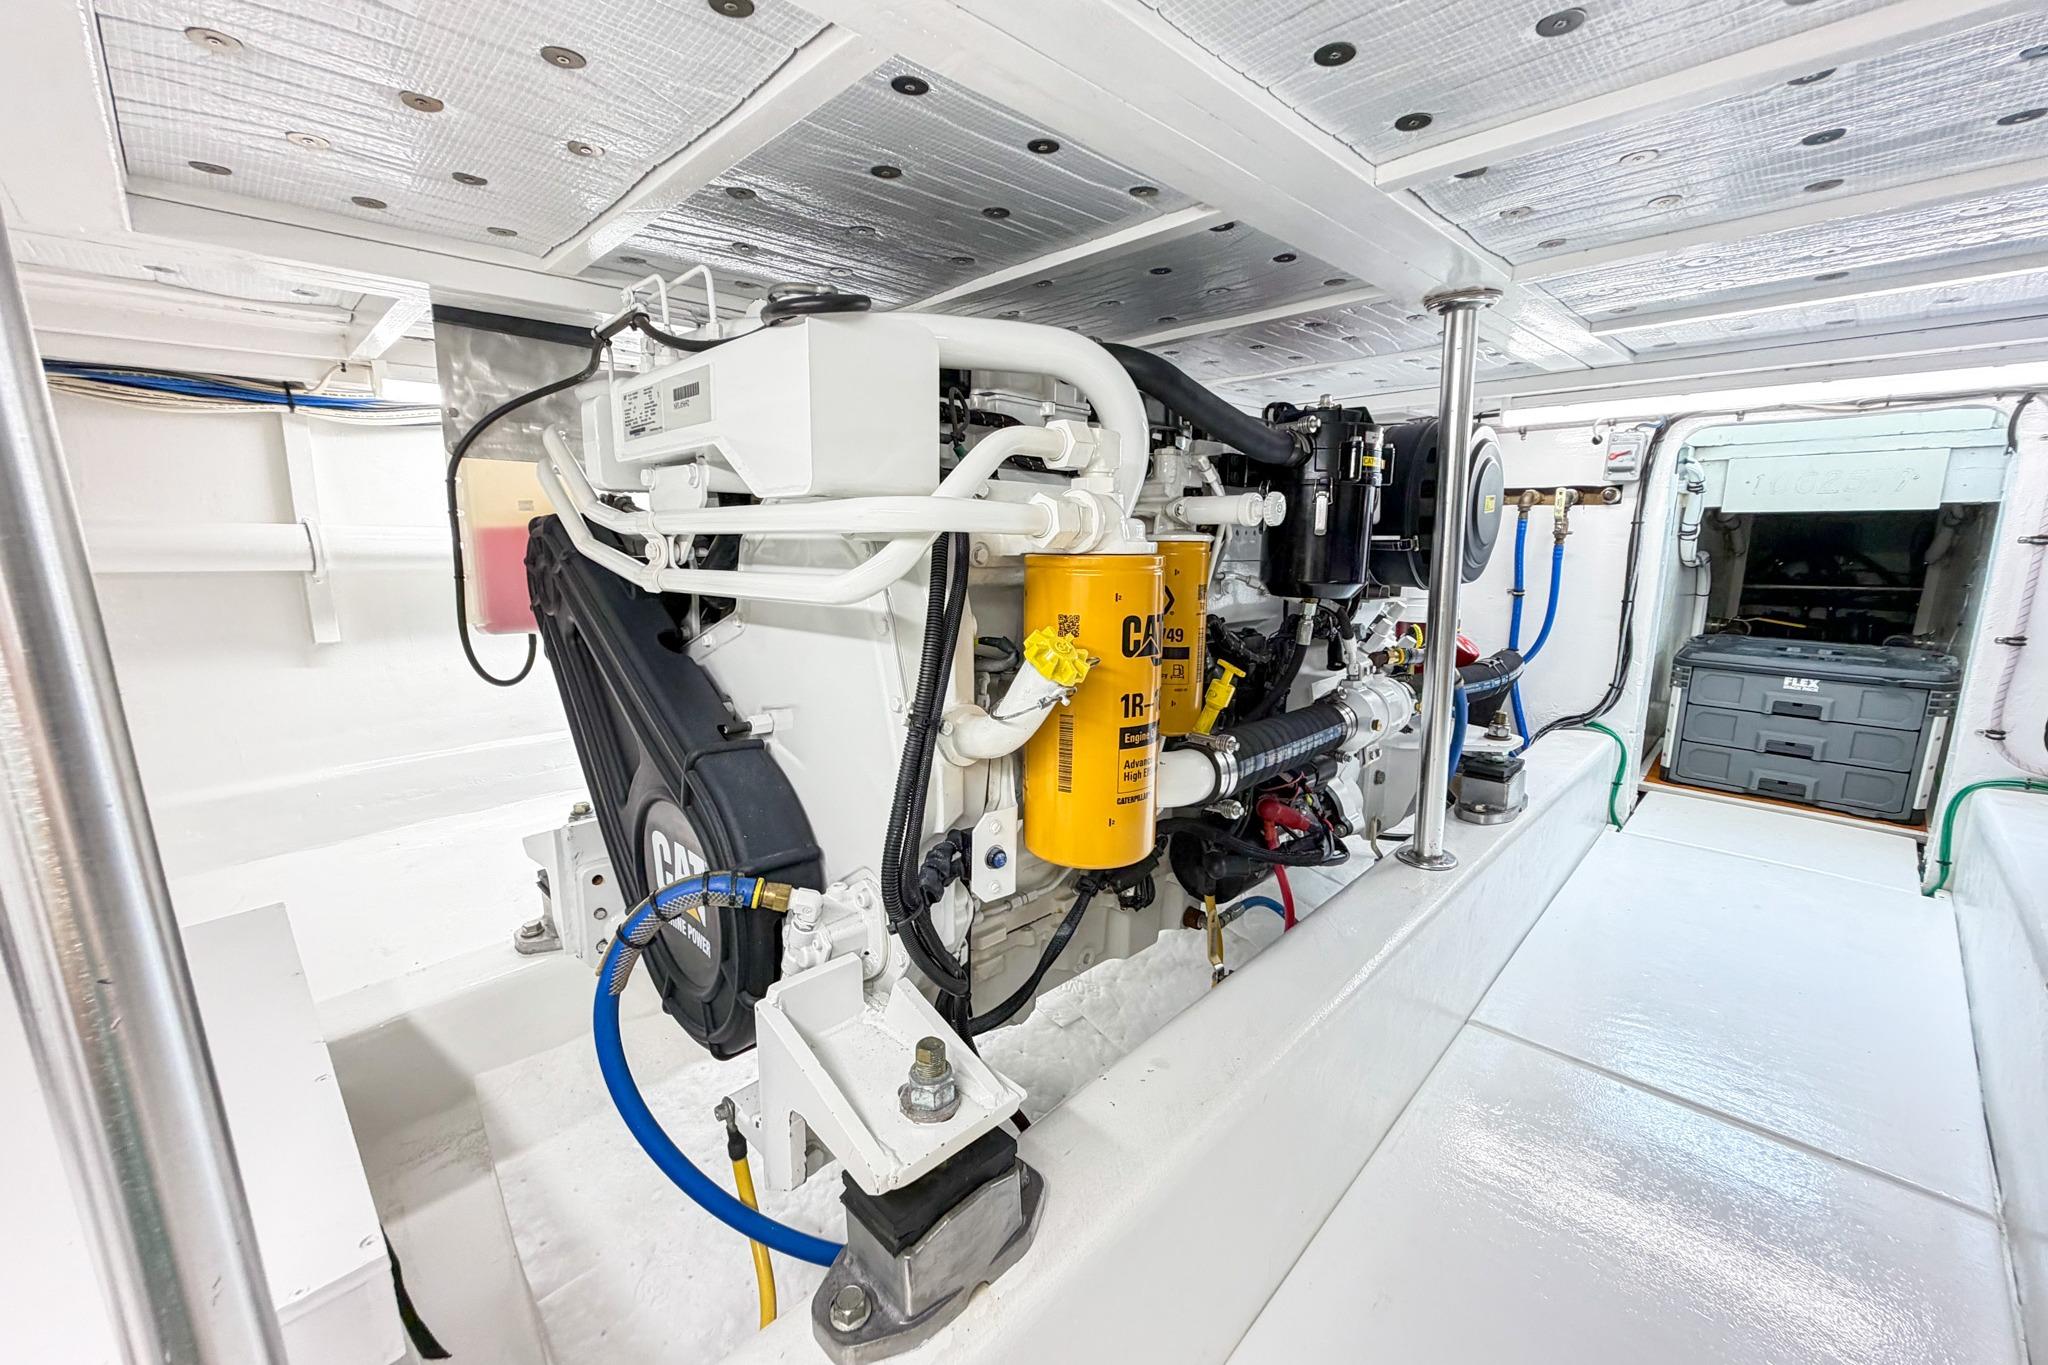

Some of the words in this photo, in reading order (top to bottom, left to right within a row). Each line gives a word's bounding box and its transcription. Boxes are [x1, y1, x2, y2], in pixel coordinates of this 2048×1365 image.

[1783, 677, 1820, 689] FLEX
[1124, 729, 1150, 745] Engine
[1123, 756, 1153, 770] Advanc
[1123, 770, 1142, 783] High
[687, 923, 712, 959] POWER
